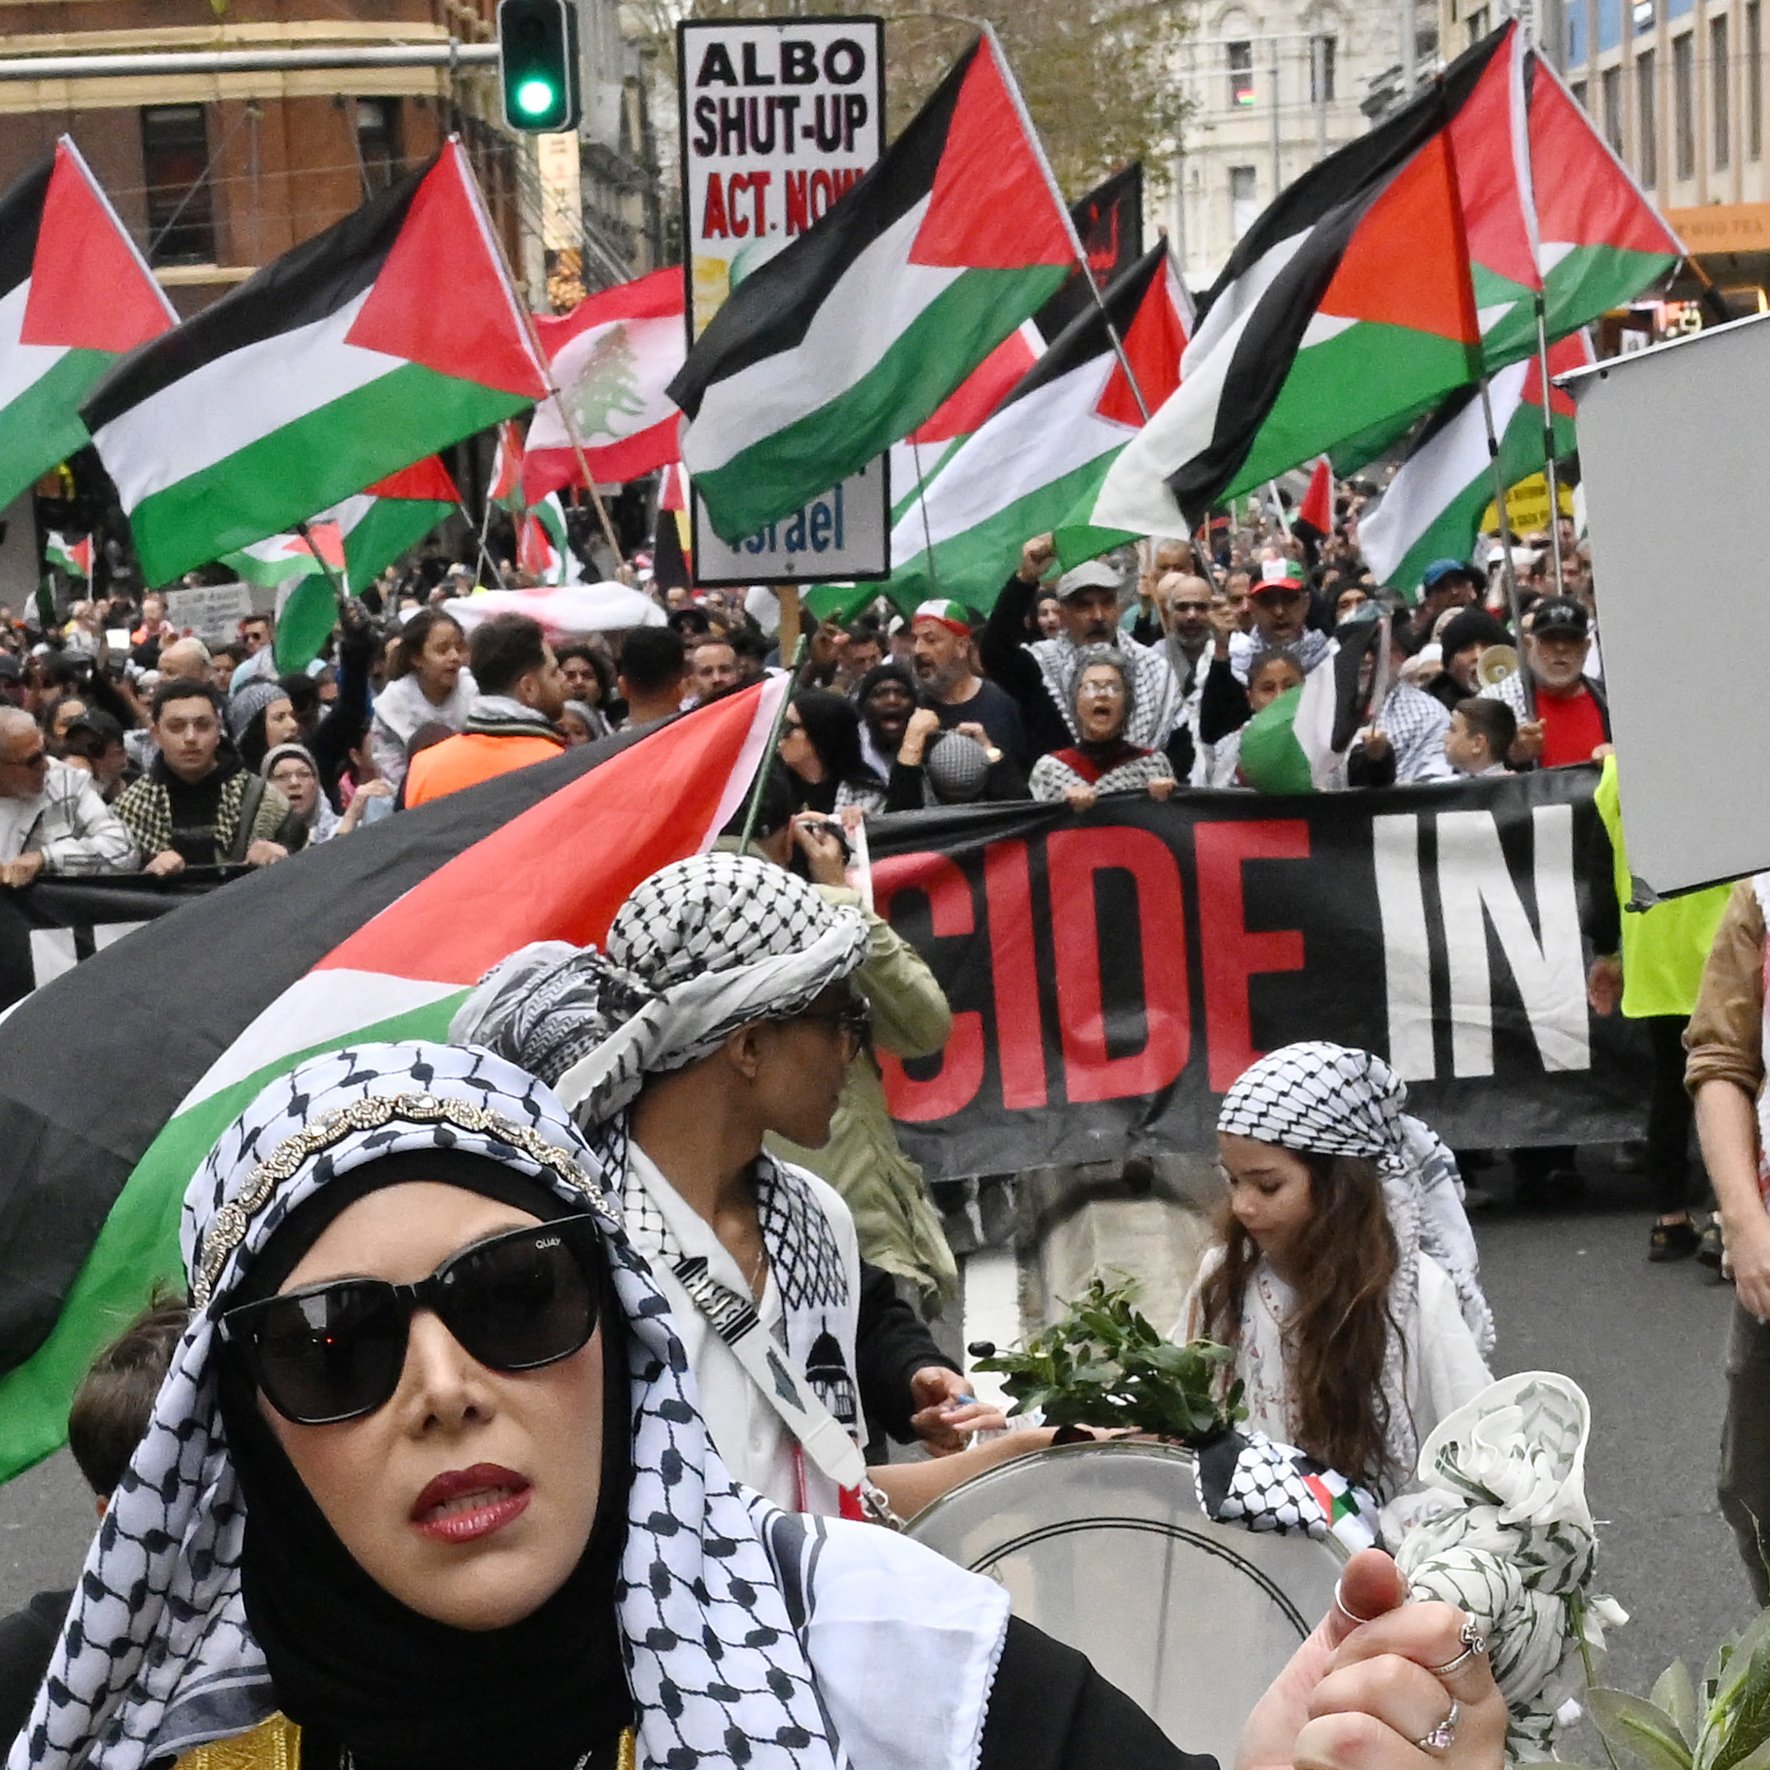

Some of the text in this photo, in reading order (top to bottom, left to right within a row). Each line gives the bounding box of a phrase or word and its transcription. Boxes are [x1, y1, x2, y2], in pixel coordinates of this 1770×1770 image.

[695, 38, 866, 87] ALBO
[693, 94, 869, 157] SHUT-UP
[870, 817, 1312, 1124] CIDE
[1371, 804, 1592, 1083] IN
[535, 1237, 562, 1250] QUAY
